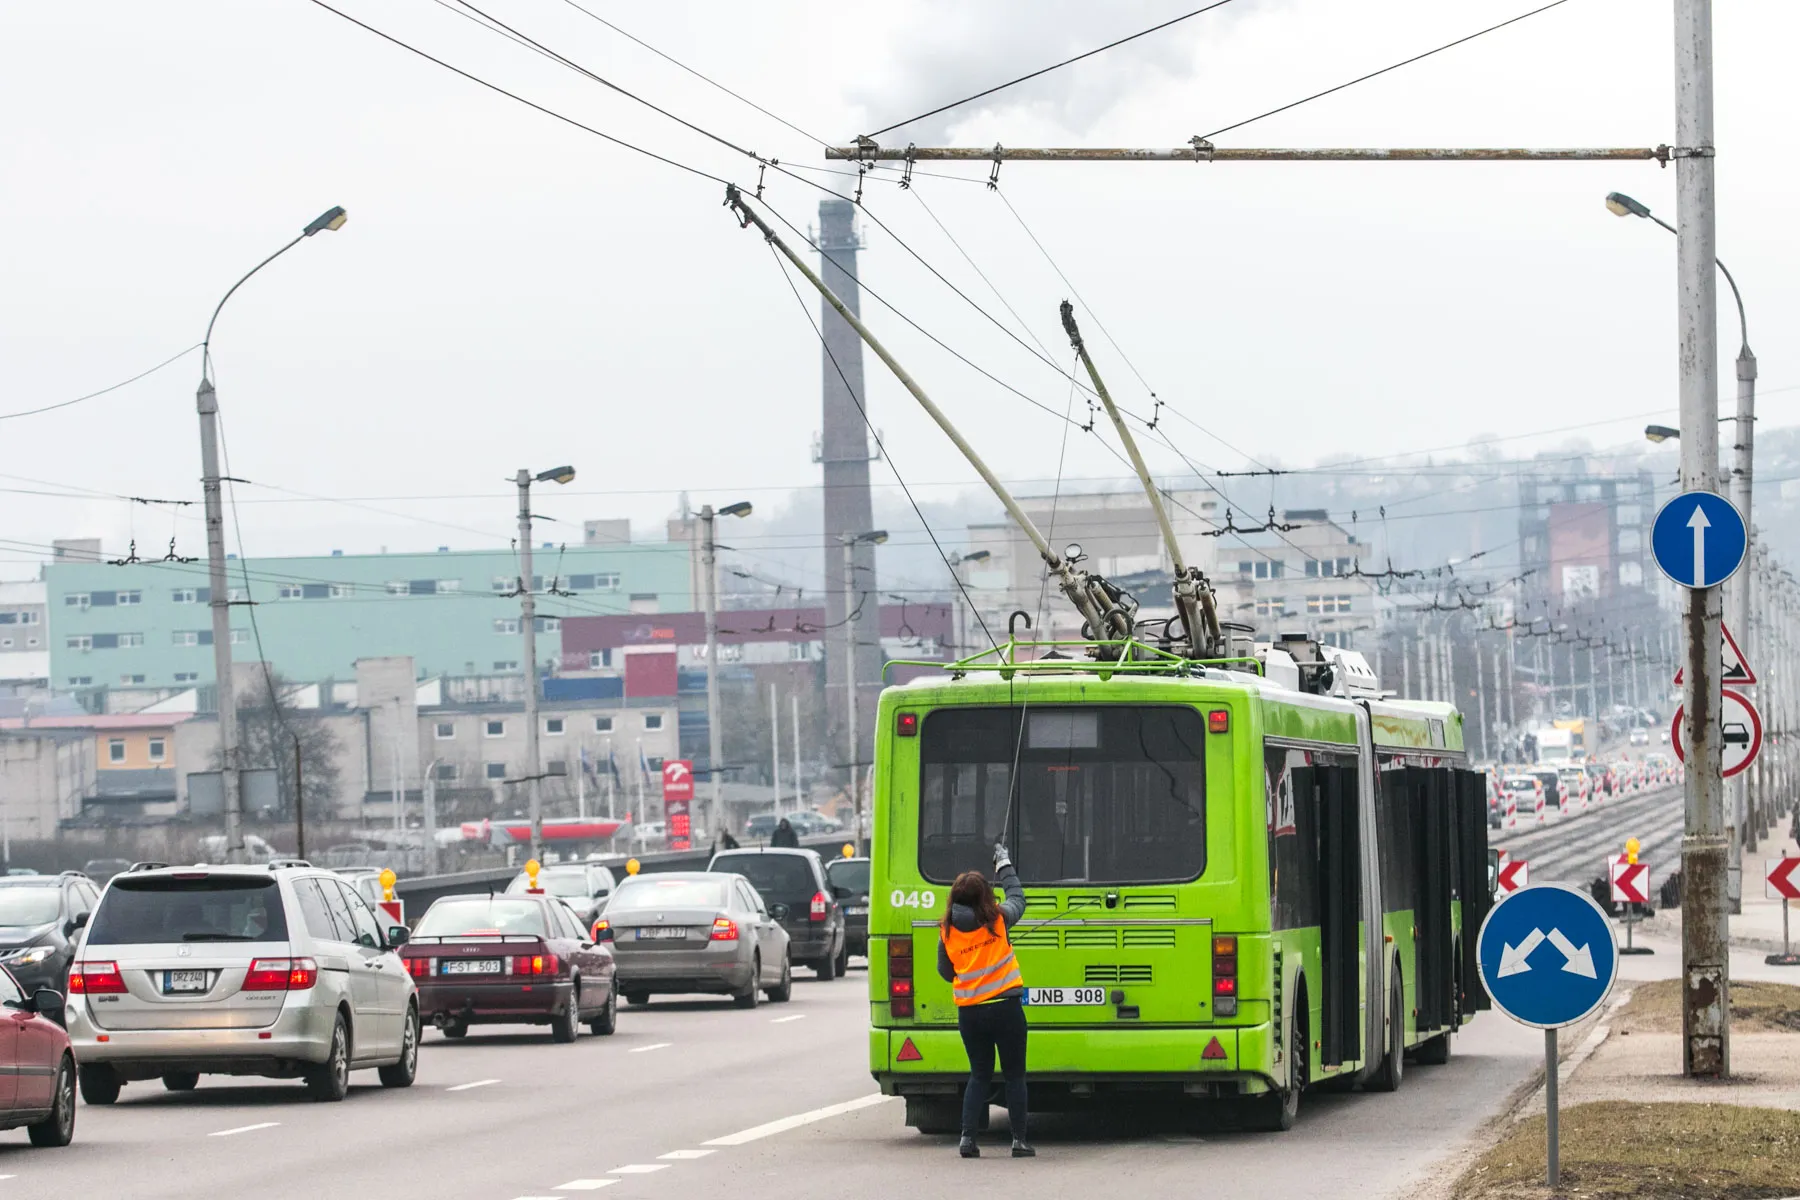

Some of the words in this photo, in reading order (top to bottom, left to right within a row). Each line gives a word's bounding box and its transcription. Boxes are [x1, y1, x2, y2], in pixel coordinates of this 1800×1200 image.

[890, 889, 935, 908] 049
[450, 962, 471, 972] FST
[479, 961, 498, 972] 503
[173, 971, 188, 982] DRZ
[190, 971, 203, 981] 240
[1031, 989, 1064, 1003] JNB
[1075, 989, 1103, 1003] 908
